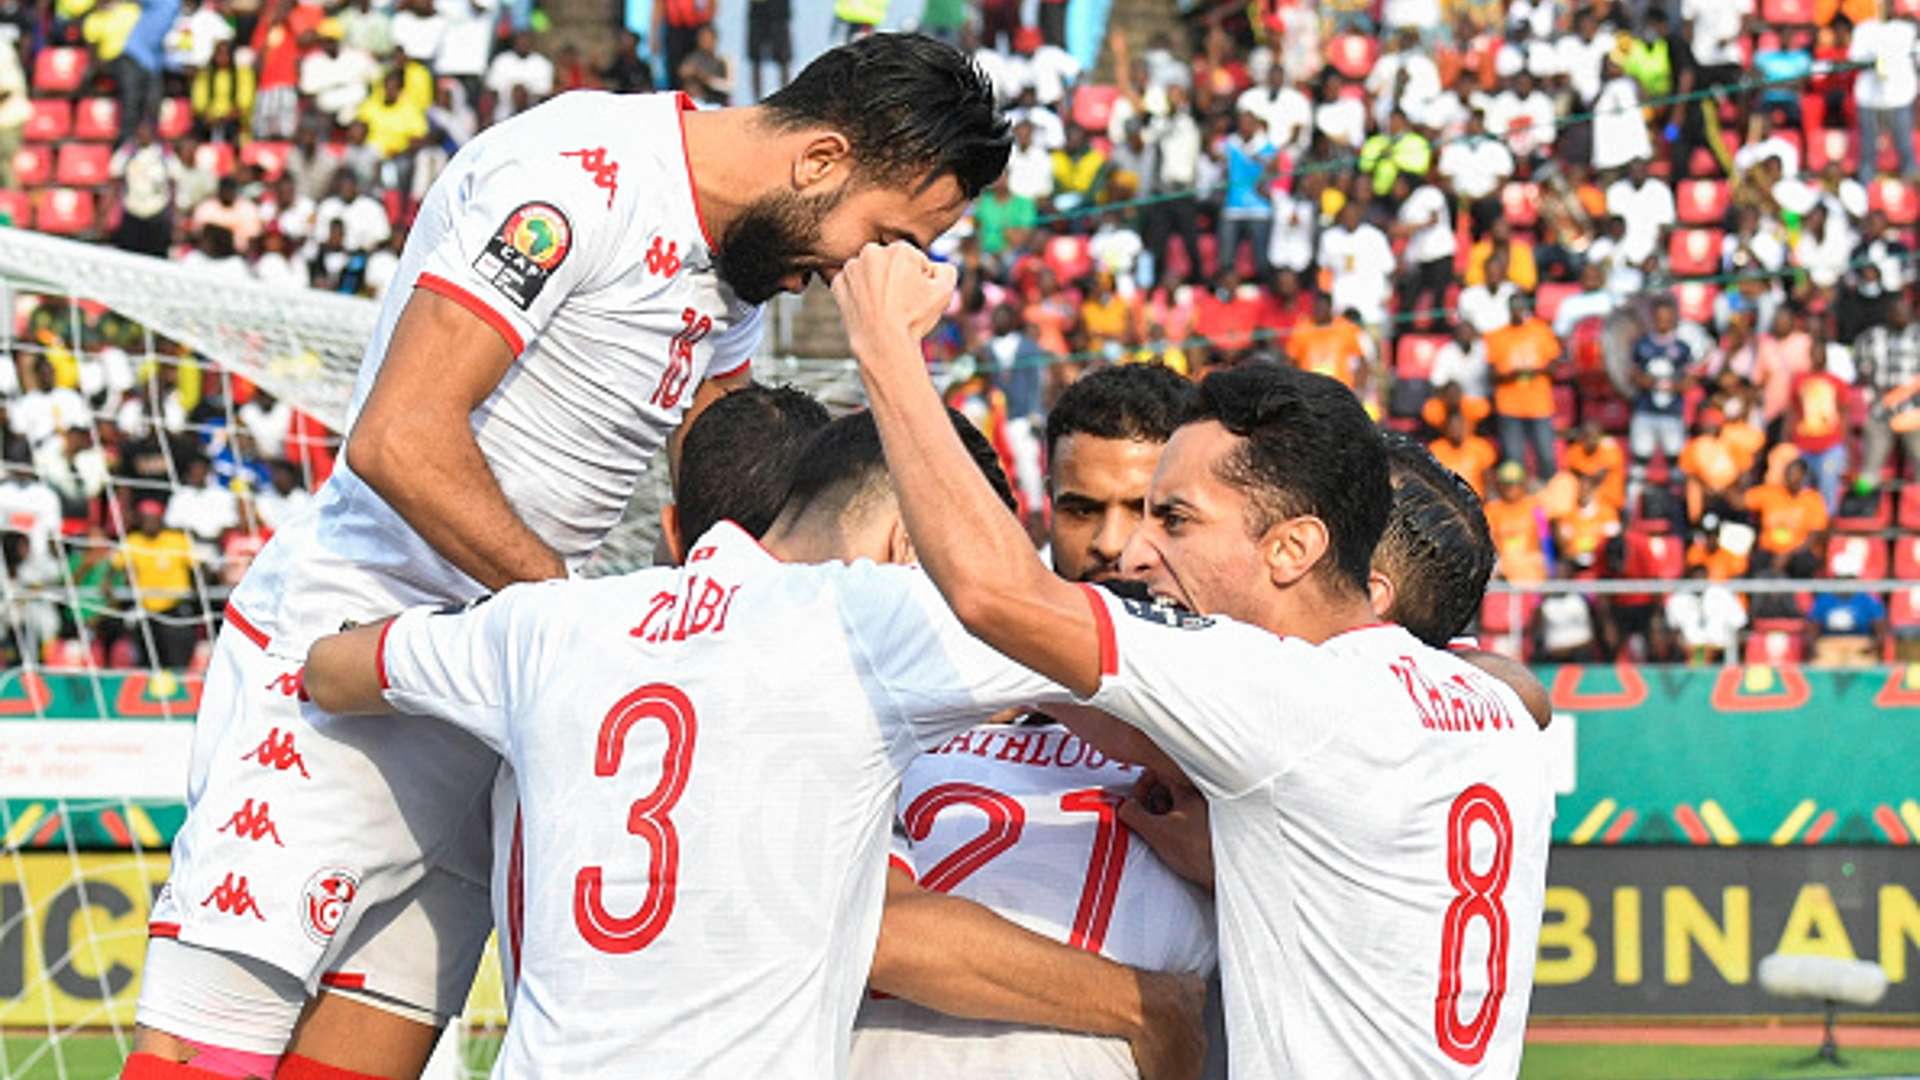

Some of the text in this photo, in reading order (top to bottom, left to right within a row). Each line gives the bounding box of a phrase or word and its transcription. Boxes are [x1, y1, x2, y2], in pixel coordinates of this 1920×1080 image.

[573, 682, 698, 954] 3
[924, 729, 1131, 771] ATHLOU
[904, 782, 1129, 953] 21
[1435, 783, 1513, 1066] 8
